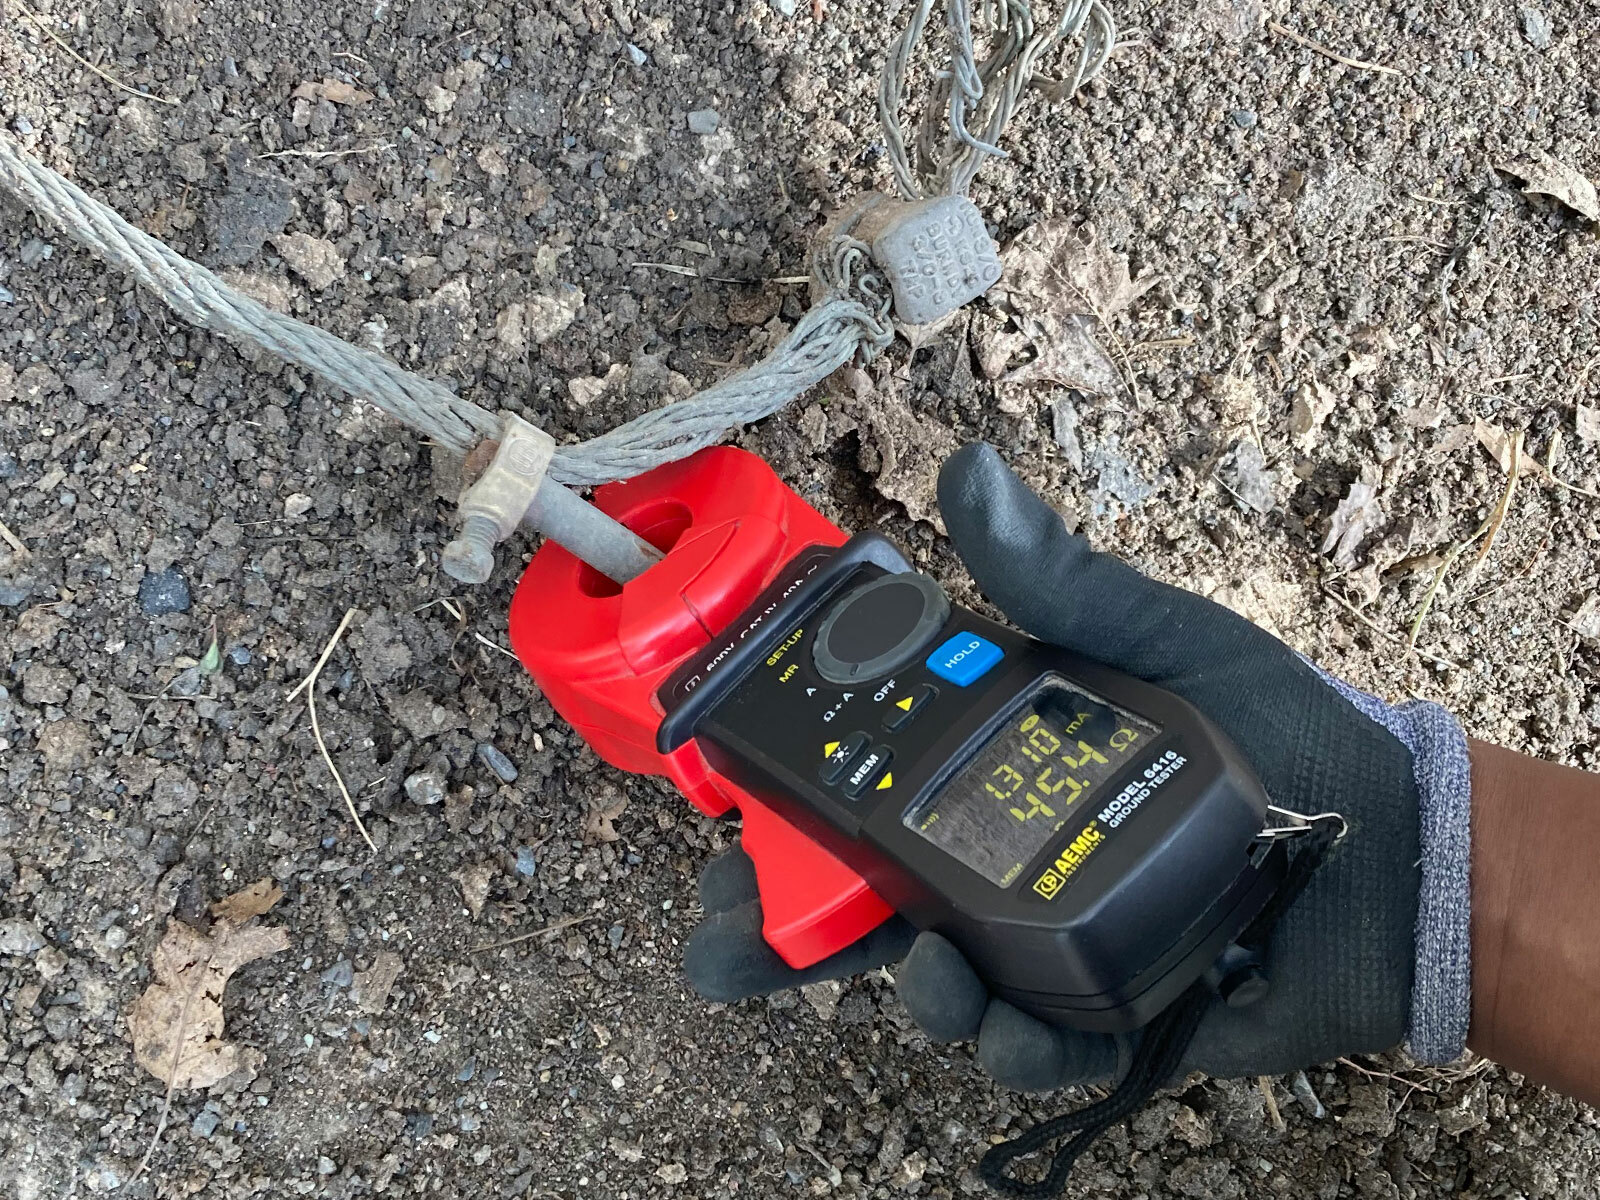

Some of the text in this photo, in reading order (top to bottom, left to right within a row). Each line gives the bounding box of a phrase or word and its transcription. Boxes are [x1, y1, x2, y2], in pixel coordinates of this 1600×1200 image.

[766, 628, 804, 667] SET-UP
[944, 640, 981, 669] HOLD
[779, 663, 800, 683] MR
[806, 686, 817, 697] A
[842, 692, 854, 702] A
[873, 678, 896, 702] OFF
[1065, 711, 1094, 735] mA
[850, 753, 879, 786] MEM
[1009, 740, 1109, 822] 45.4
[1097, 779, 1147, 823] MODEL
[1143, 750, 1178, 779] 6416
[1064, 755, 1187, 879] INSTRUMENTS GROUND TESTER
[1000, 862, 1023, 885] MEM
